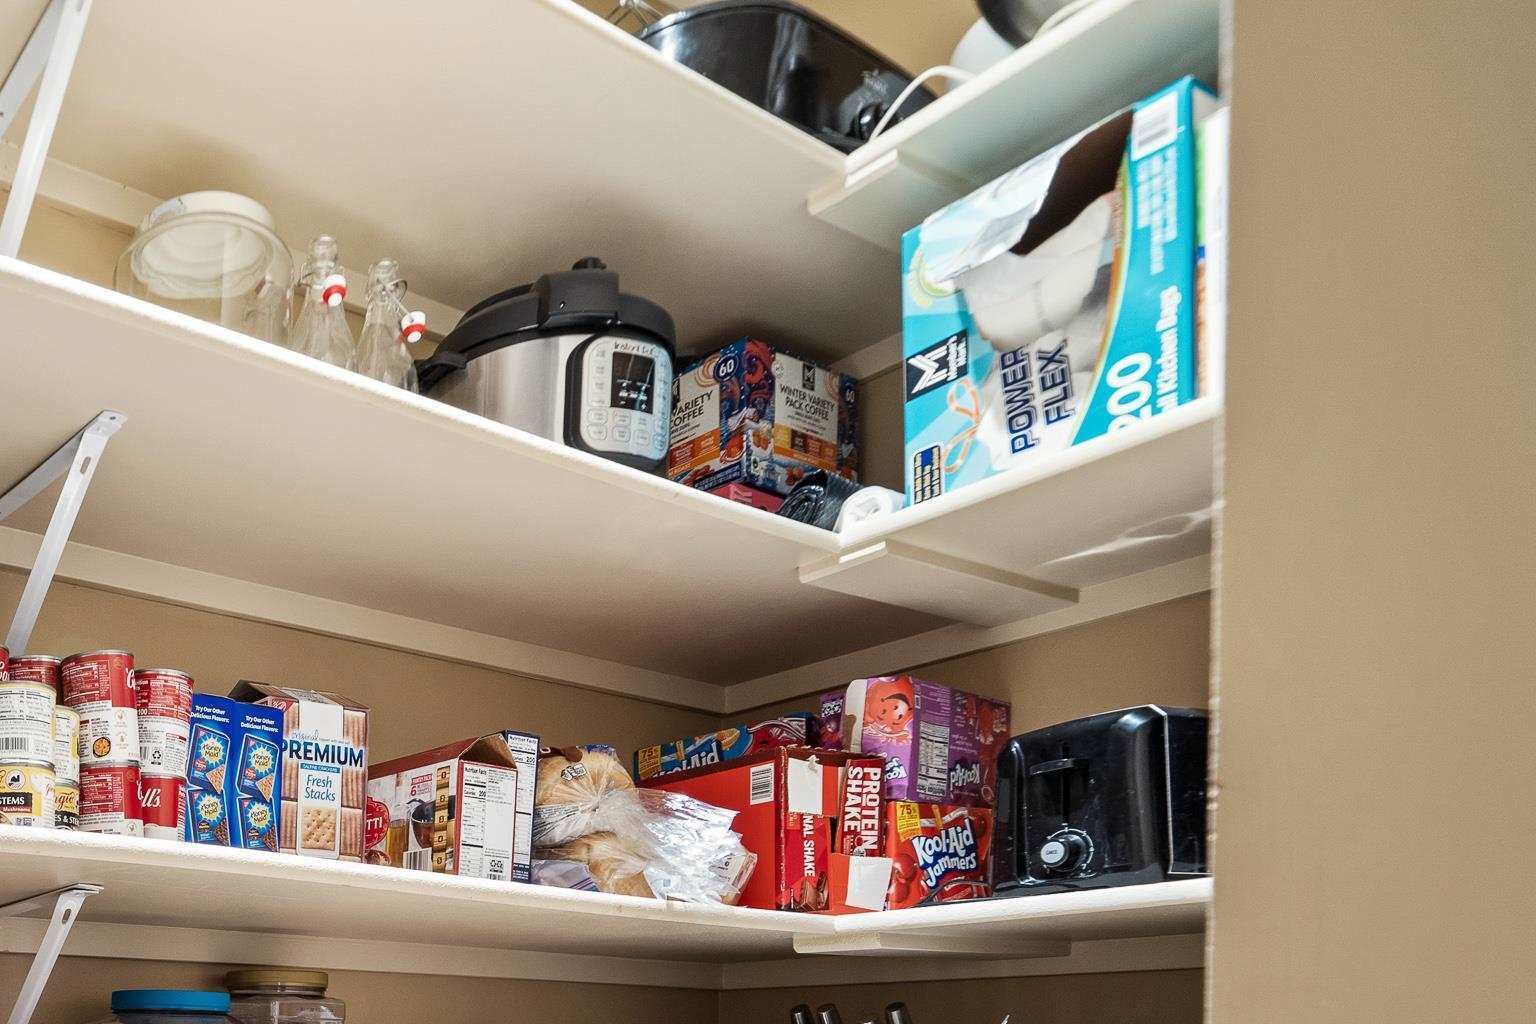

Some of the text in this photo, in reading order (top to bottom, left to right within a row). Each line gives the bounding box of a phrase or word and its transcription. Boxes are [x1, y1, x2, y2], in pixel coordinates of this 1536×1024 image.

[720, 359, 735, 377] 60
[1036, 338, 1076, 426] FLEX
[780, 384, 835, 412] WINTER VARIETY
[785, 397, 830, 421] PACK COFFEE
[1000, 343, 1039, 454] POWER
[212, 708, 226, 716] Other
[262, 718, 276, 726] Other
[241, 722, 263, 731] Delicious
[526, 756, 536, 764] 200
[306, 775, 332, 788] Fresh
[410, 784, 417, 797] 6
[304, 787, 336, 802] Stacks
[843, 766, 863, 832] SHAKE
[860, 767, 882, 850] PROTEIN
[912, 817, 976, 867] Kool-Aid
[801, 839, 816, 878] SHAKE
[924, 850, 978, 888] Jammers
